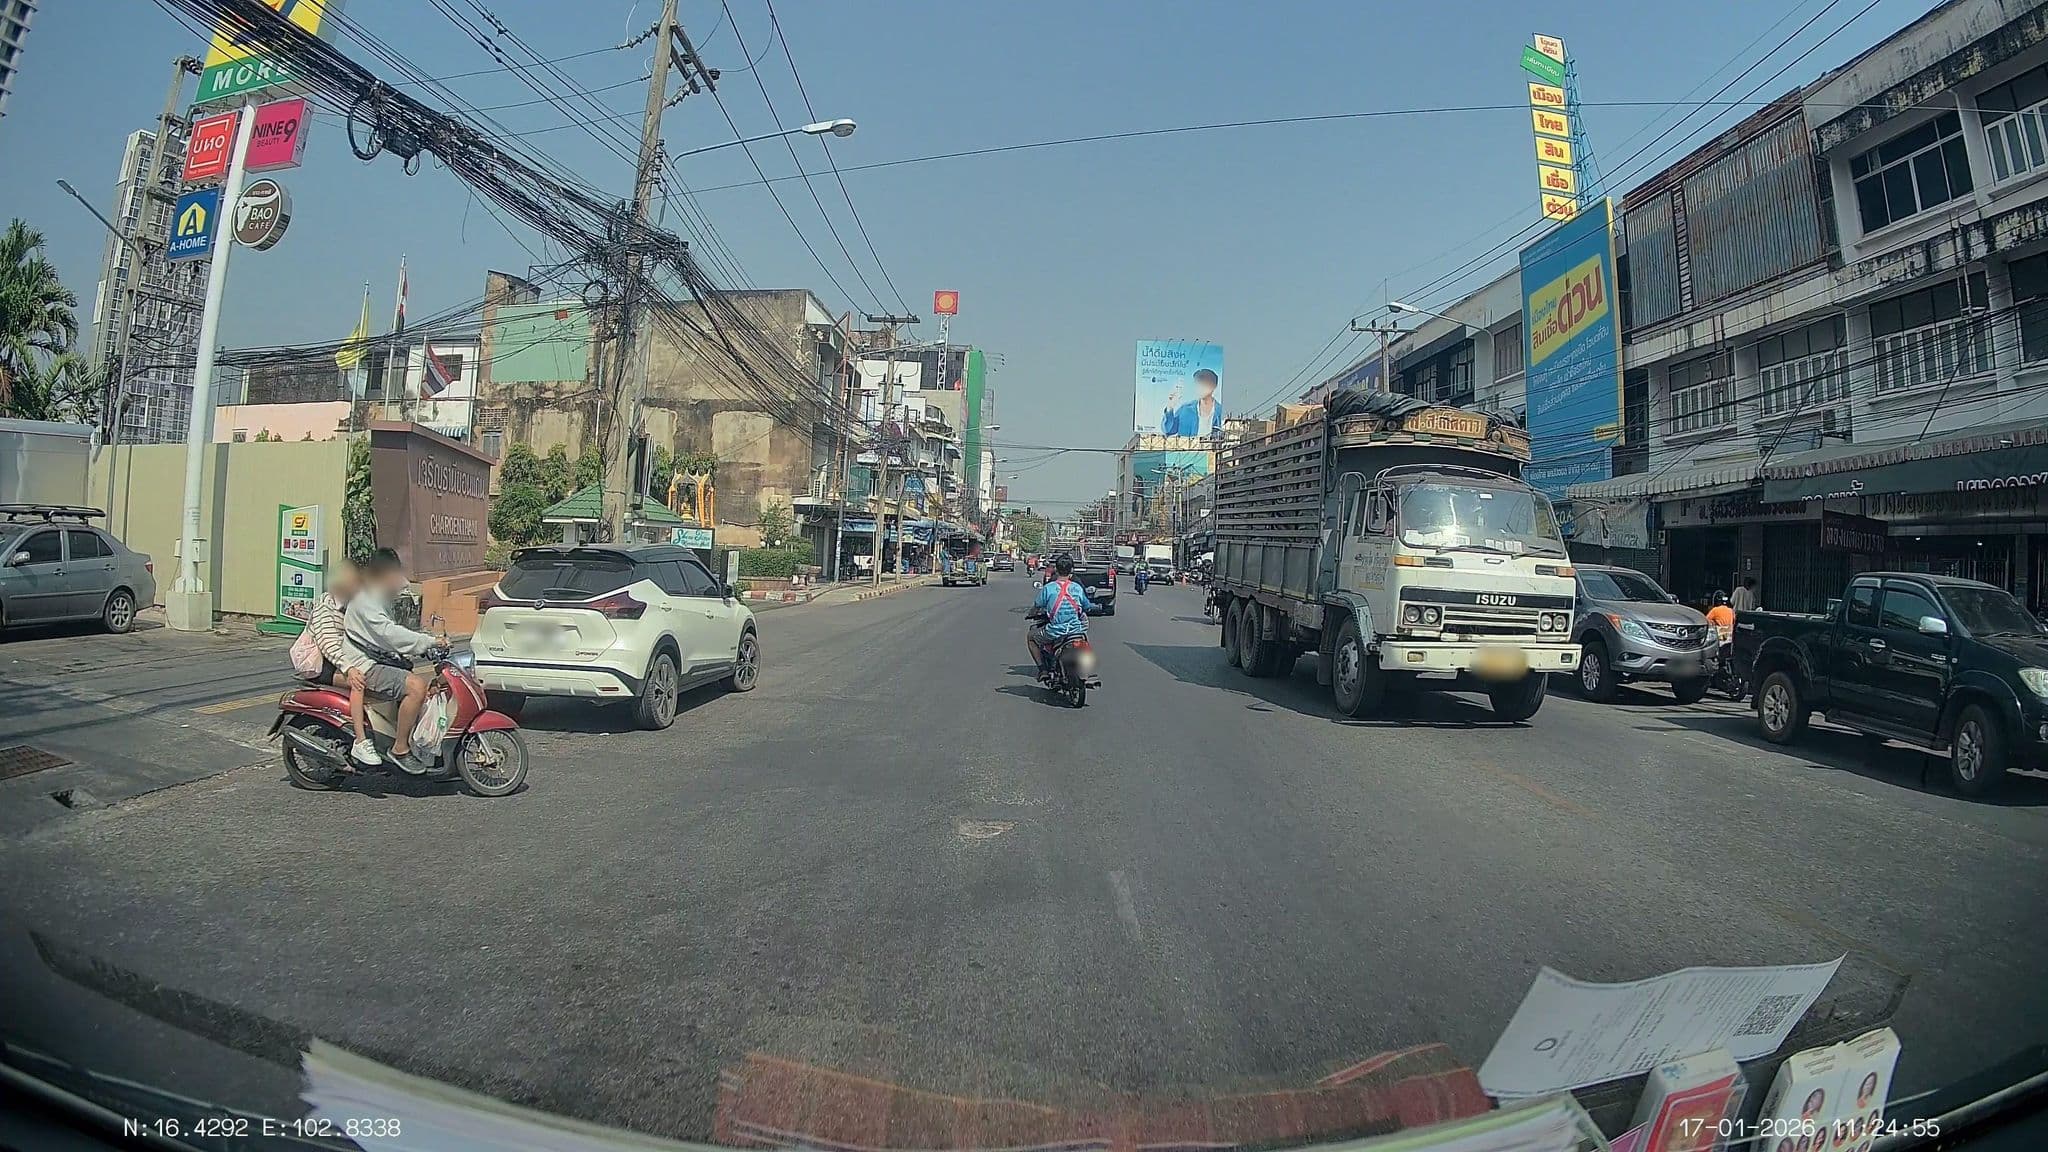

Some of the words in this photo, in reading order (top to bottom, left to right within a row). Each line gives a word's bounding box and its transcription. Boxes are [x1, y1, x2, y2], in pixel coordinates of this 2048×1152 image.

[1538, 113, 1564, 131] ไทย
[256, 137, 280, 148] BEAUTY
[250, 207, 273, 220] BAO
[1546, 199, 1574, 217] ด่วน
[169, 236, 207, 252] A-HOME
[1532, 314, 1558, 349] สินเชื่อ
[1557, 264, 1603, 334] ด่วน
[1475, 594, 1517, 606] ISUZU
